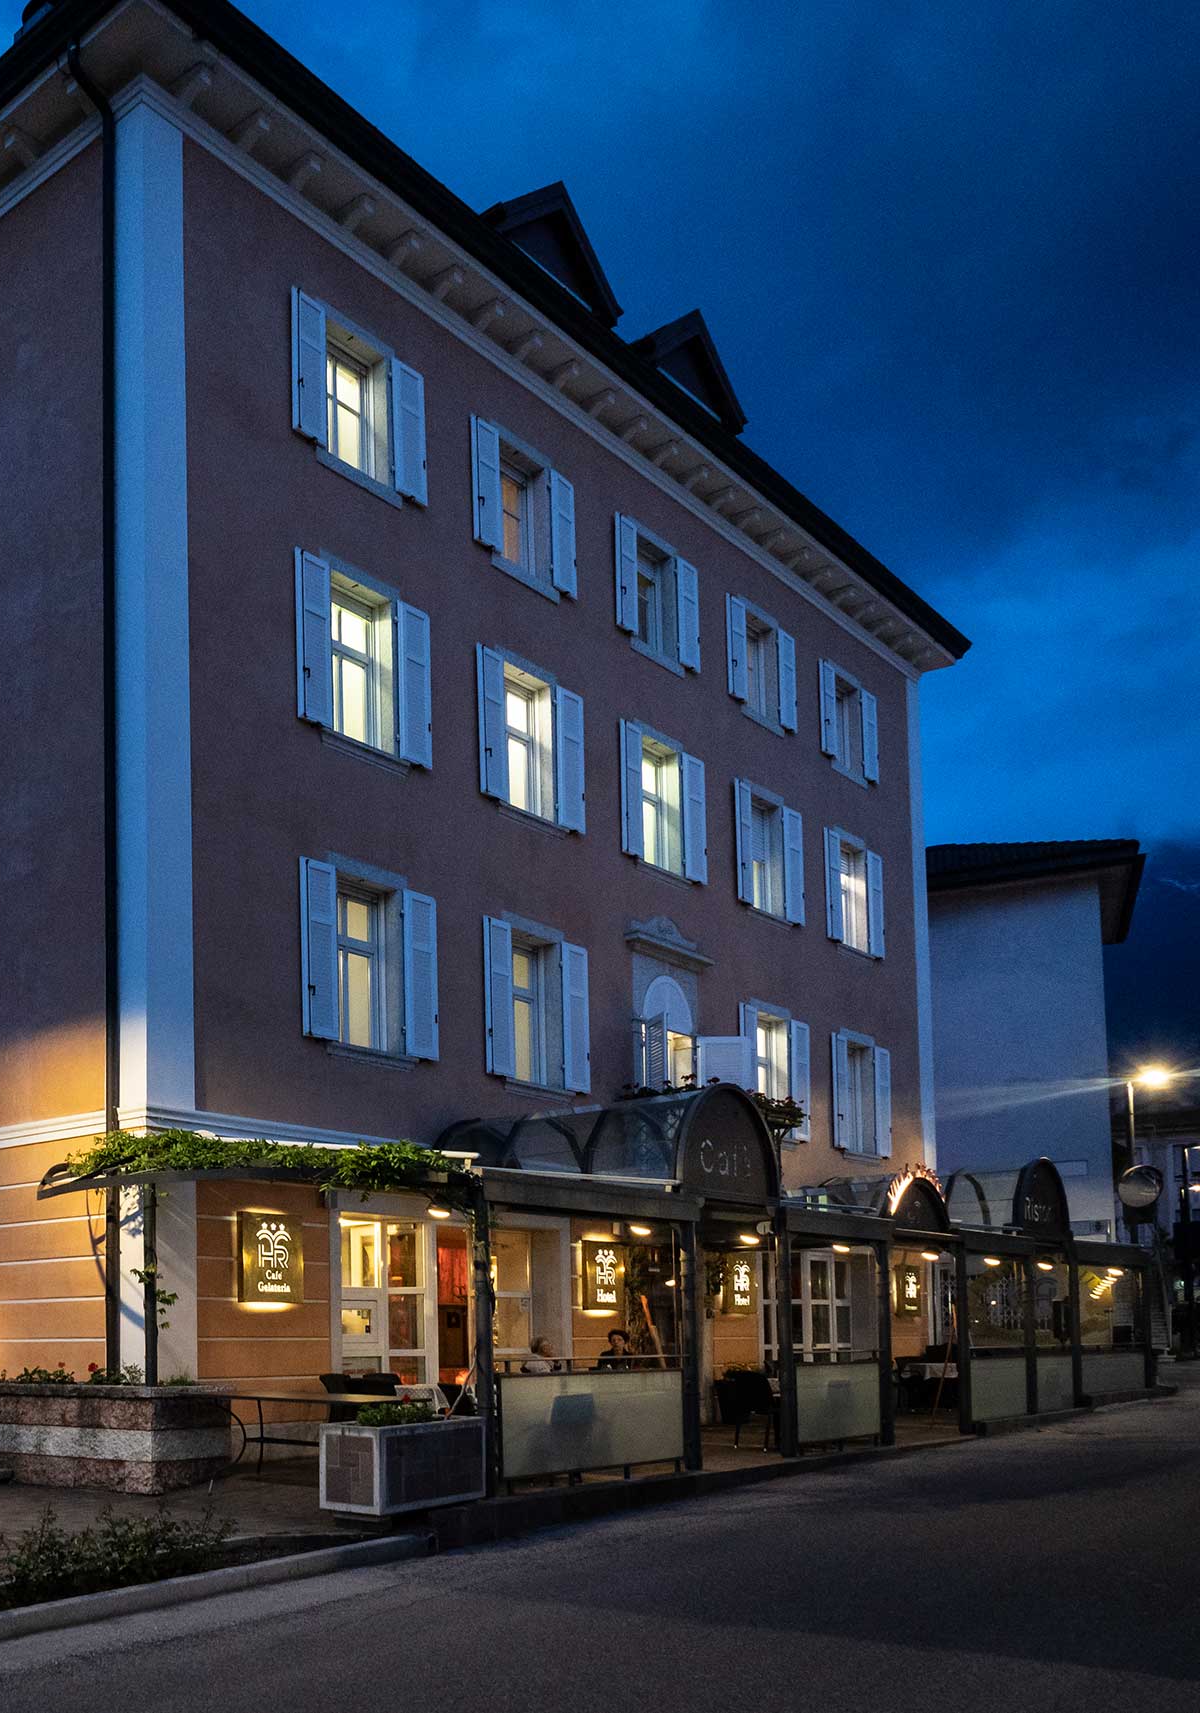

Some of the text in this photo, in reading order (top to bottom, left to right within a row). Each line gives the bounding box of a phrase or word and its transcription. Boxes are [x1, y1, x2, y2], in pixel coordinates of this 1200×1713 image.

[257, 1282, 291, 1293] Gelateria
[596, 1289, 617, 1304] Hotel
[734, 1294, 751, 1306] Hotel
